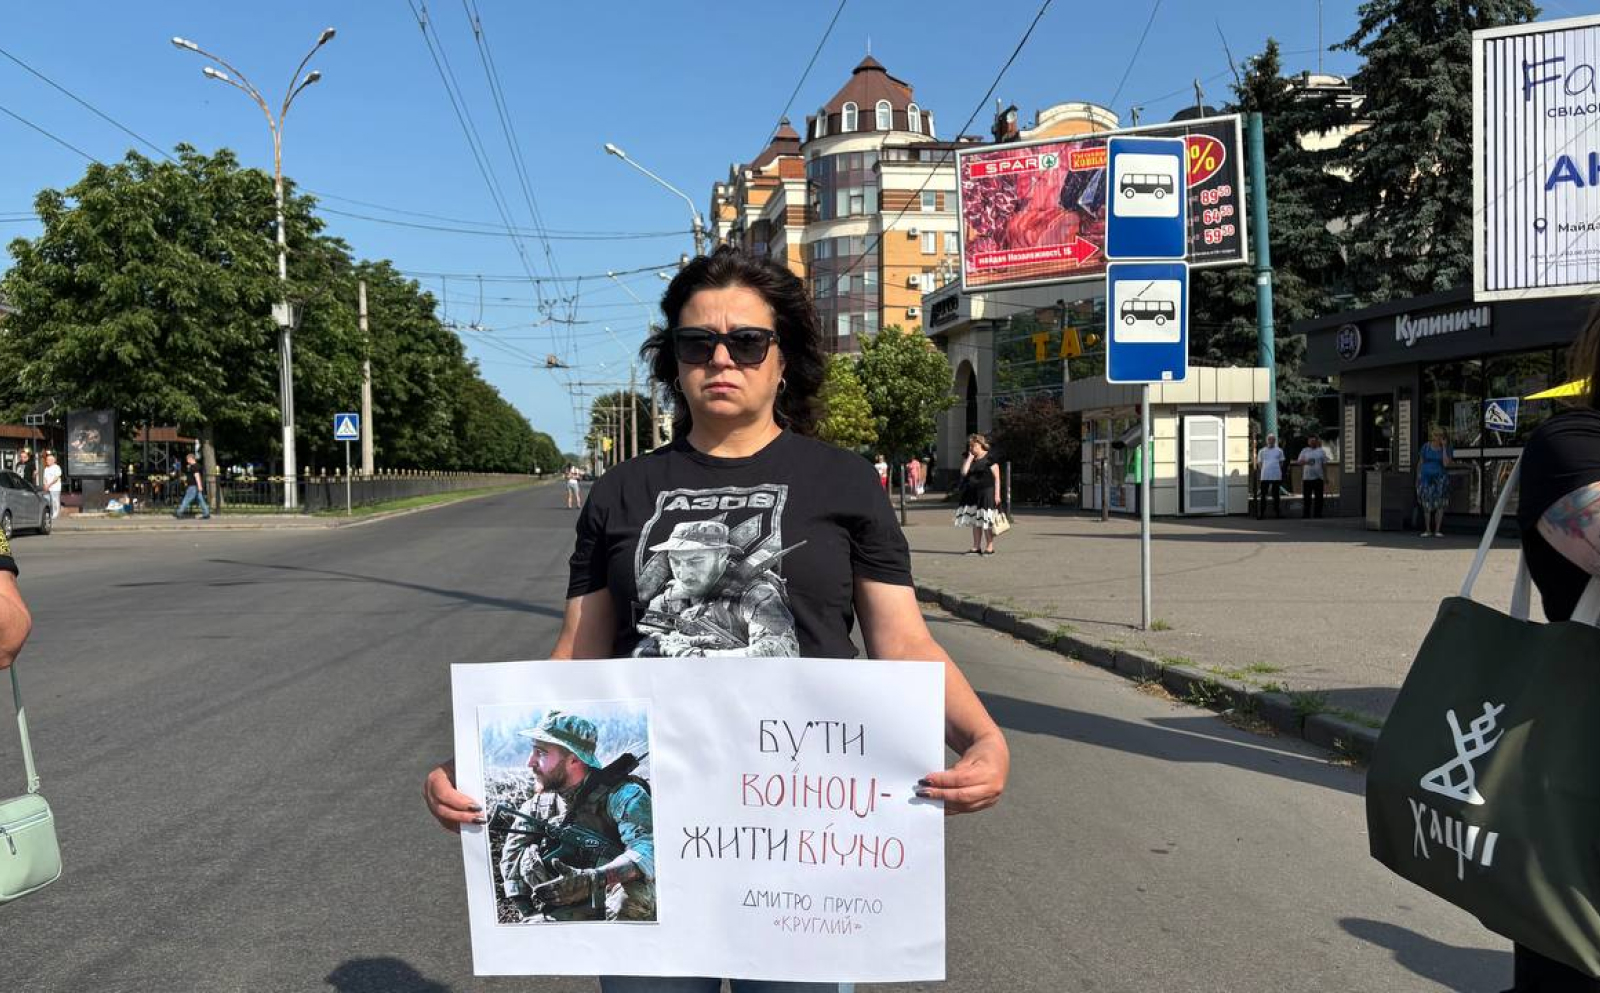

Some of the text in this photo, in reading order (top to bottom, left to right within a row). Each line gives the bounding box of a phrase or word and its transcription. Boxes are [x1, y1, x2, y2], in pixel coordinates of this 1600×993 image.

[1547, 103, 1600, 118] СВІДО
[985, 158, 1038, 173] SPAR
[663, 493, 775, 511] АЗОВ
[760, 719, 865, 762] БУТИ
[681, 823, 905, 869] ЖИТИ ВІЧНО
[743, 889, 883, 914] ДМИТРО ПРУГЛО
[773, 916, 862, 935] «КРУГЛИЙ»
